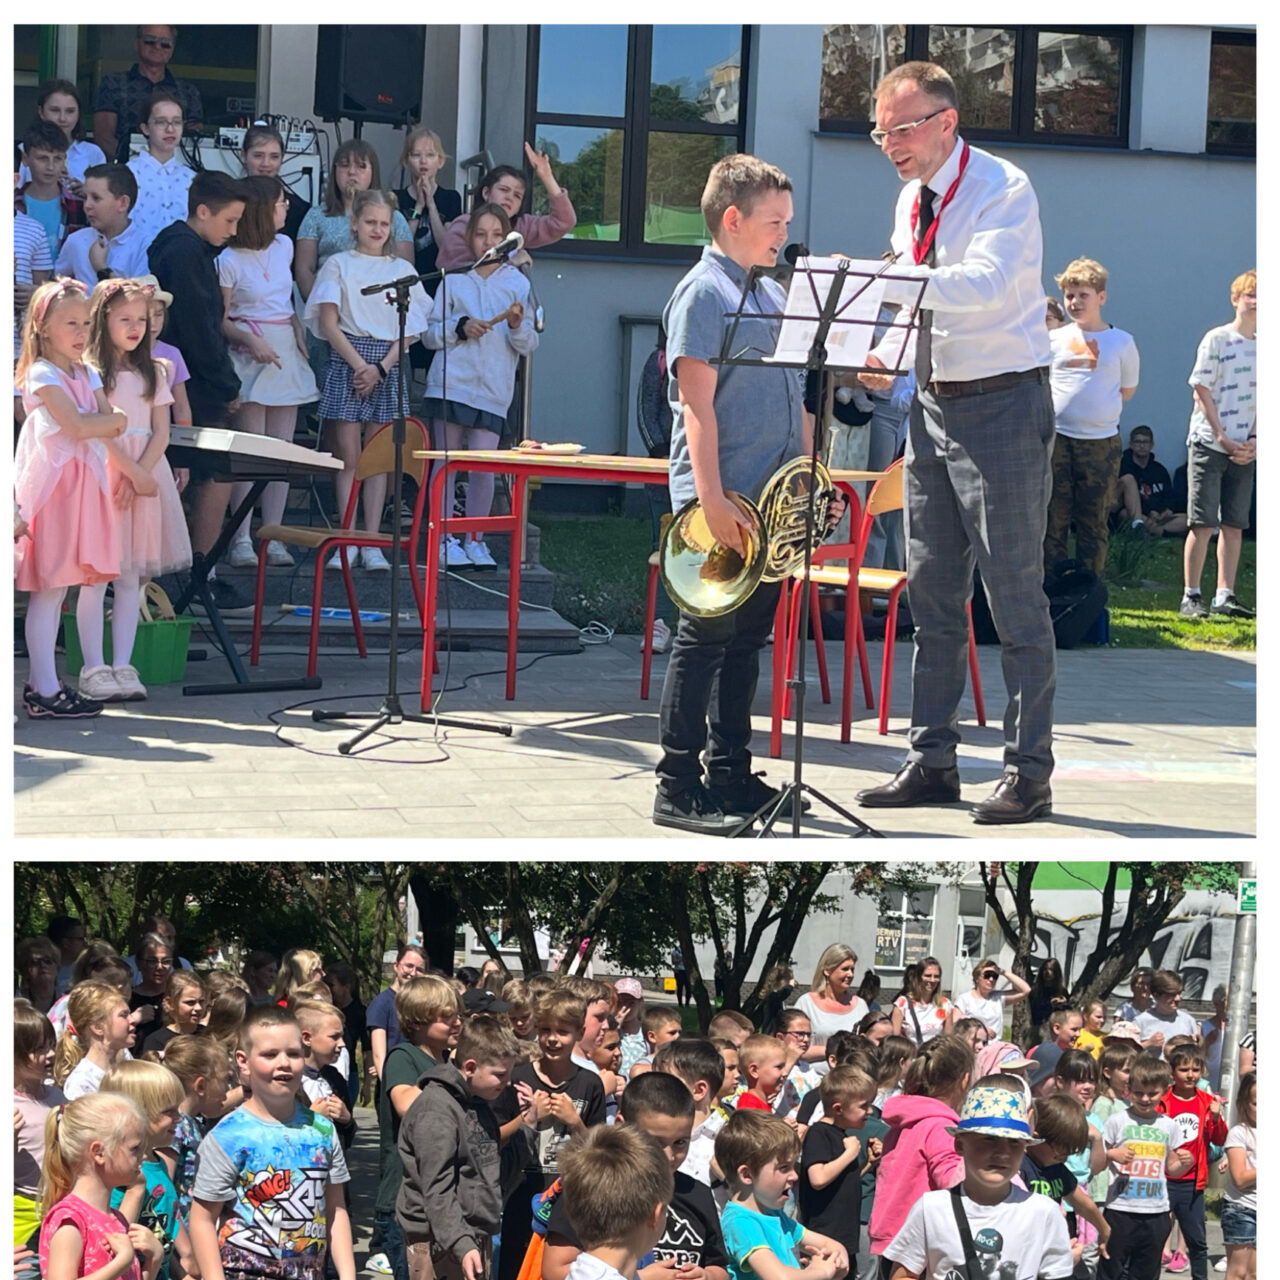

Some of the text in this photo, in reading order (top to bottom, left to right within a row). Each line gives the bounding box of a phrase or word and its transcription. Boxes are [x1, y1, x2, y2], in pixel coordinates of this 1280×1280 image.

[877, 936, 899, 948] RTV
[1131, 1127, 1163, 1141] LESS
[1182, 1129, 1188, 1139] 1
[653, 1248, 701, 1269] appa
